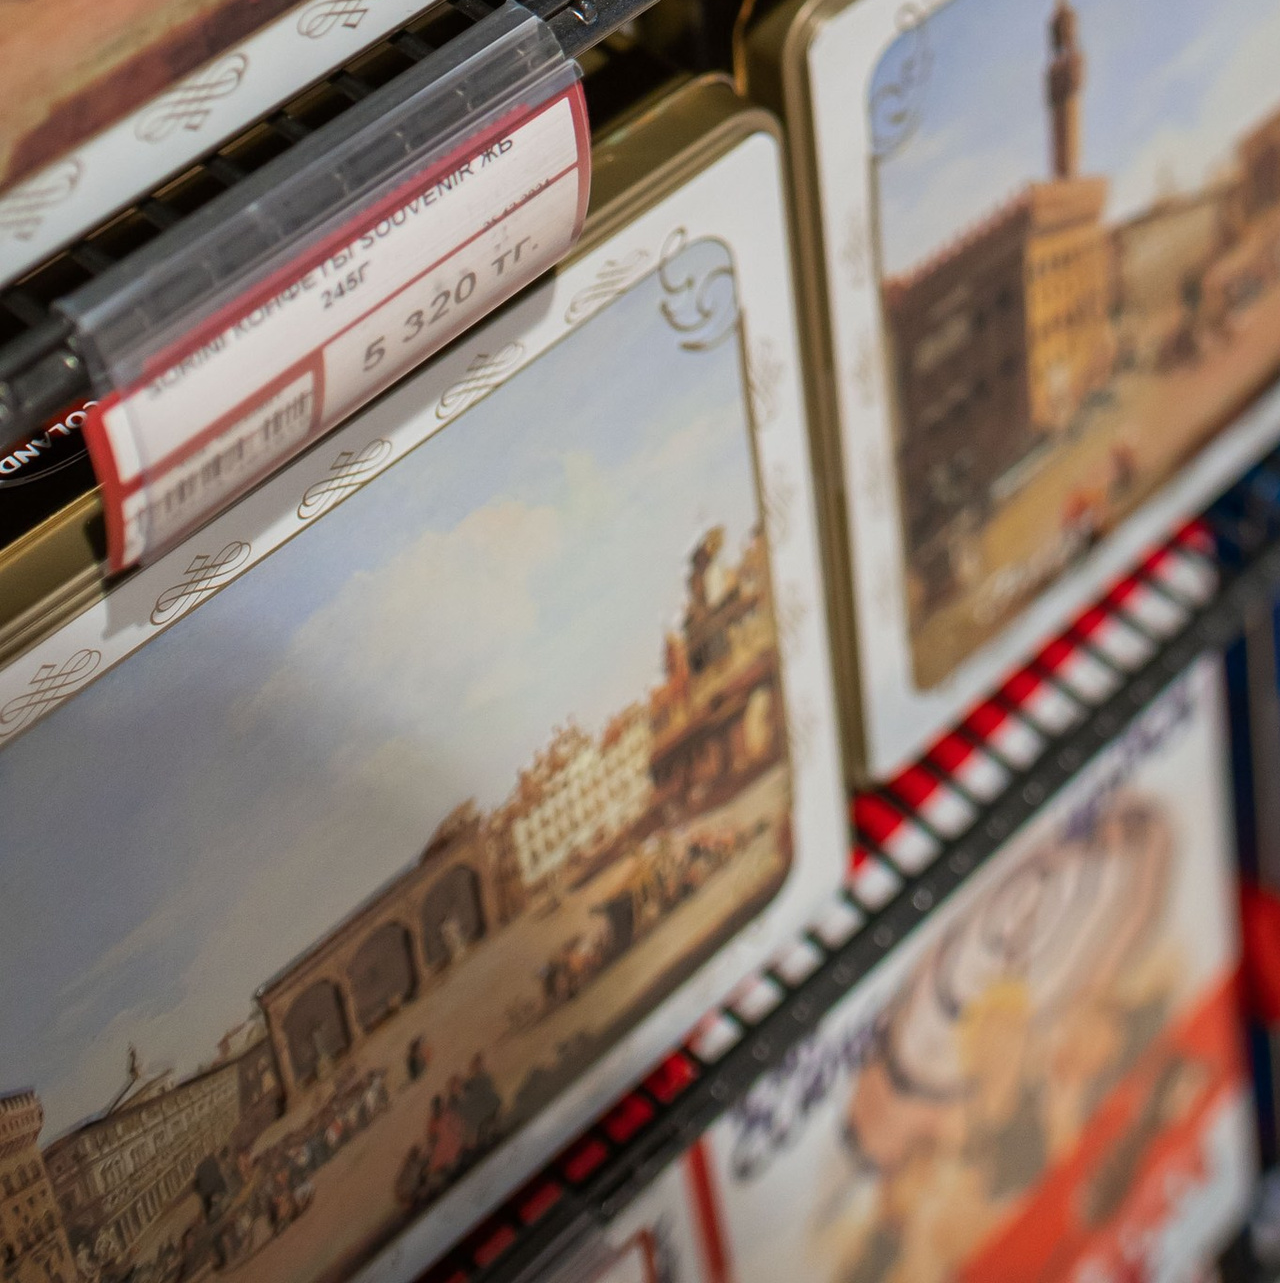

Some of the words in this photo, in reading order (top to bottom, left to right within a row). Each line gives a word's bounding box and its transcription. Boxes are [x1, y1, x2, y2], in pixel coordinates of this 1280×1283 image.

[358, 159, 474, 250] SOUVENIR
[362, 336, 386, 372] 5
[402, 272, 477, 343] 320
